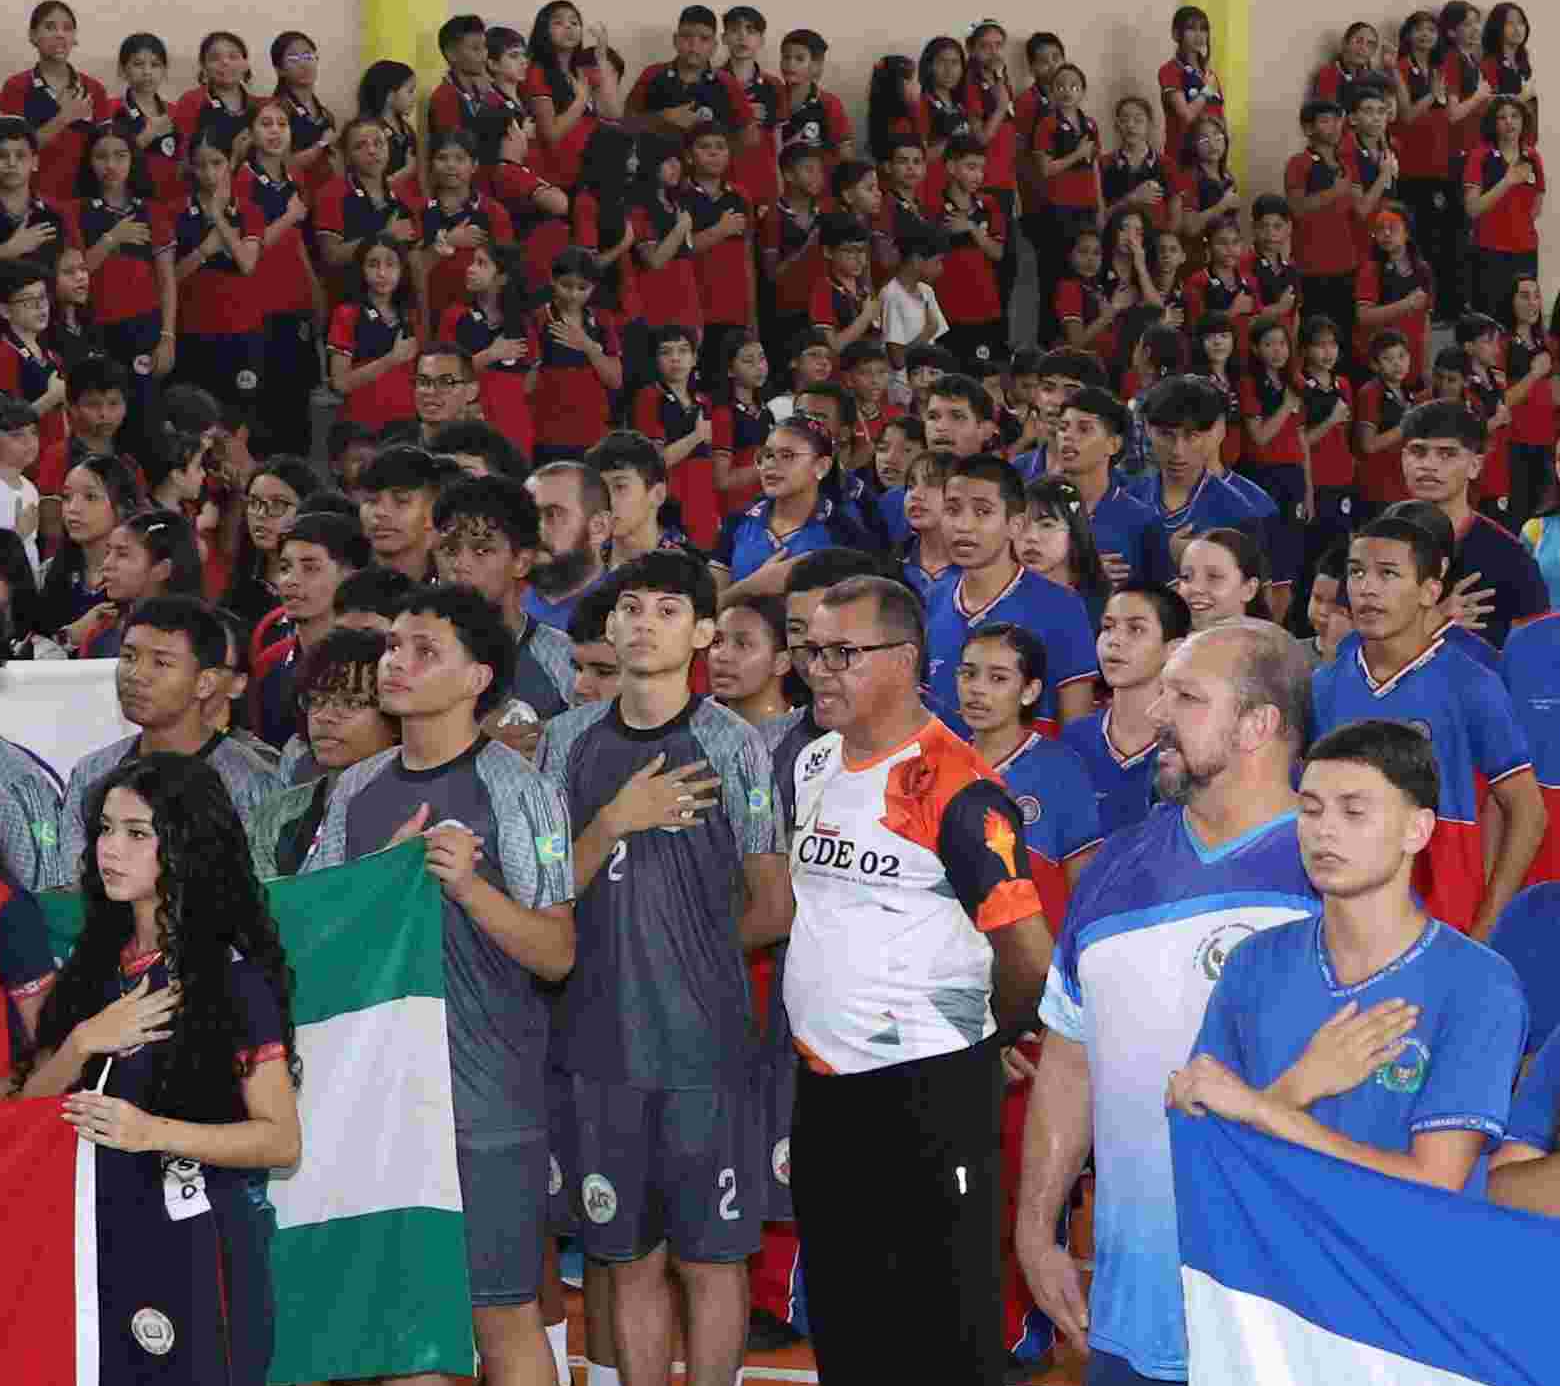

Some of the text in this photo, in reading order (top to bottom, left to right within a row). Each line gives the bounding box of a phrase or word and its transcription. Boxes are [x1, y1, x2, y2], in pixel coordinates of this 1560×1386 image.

[607, 839, 628, 882] 2
[798, 834, 901, 878] CDE 02
[718, 1167, 739, 1221] 2
